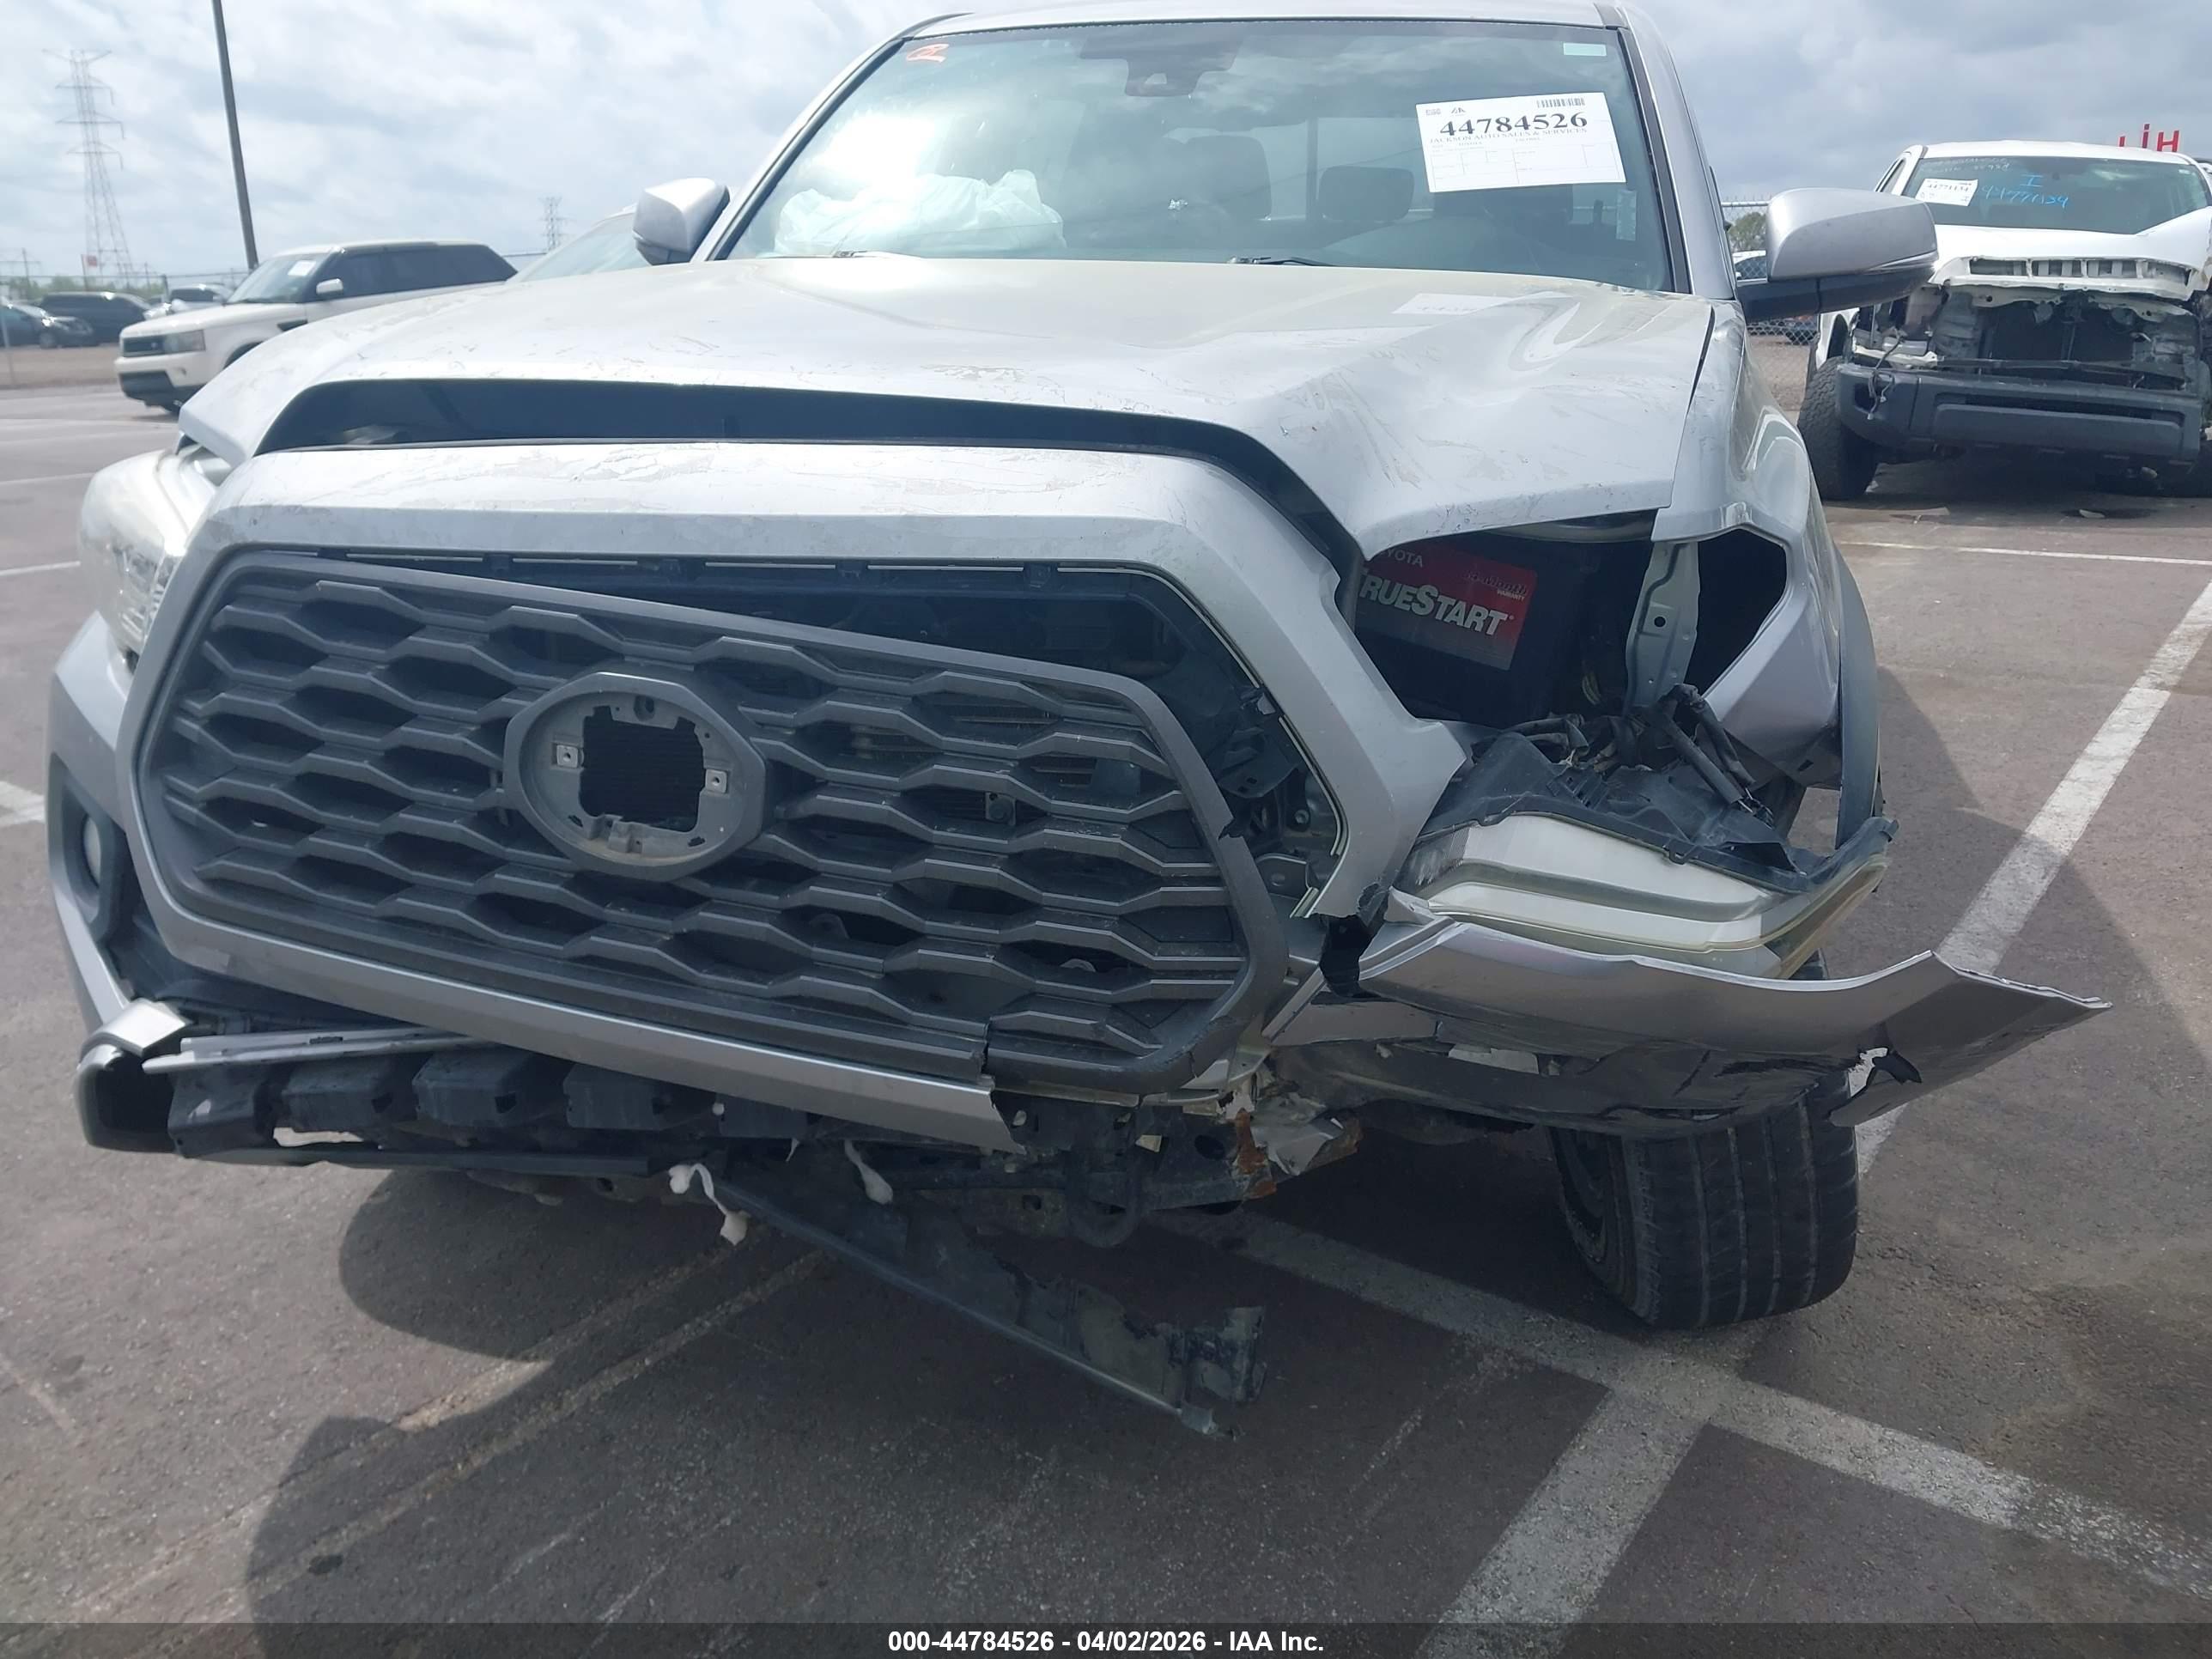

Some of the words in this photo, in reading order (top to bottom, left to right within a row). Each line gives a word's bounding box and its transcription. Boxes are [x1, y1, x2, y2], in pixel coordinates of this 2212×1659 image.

[1440, 112, 1588, 136] 44784526
[1382, 548, 1423, 568] YOTA
[1358, 572, 1508, 635] RUESTART
